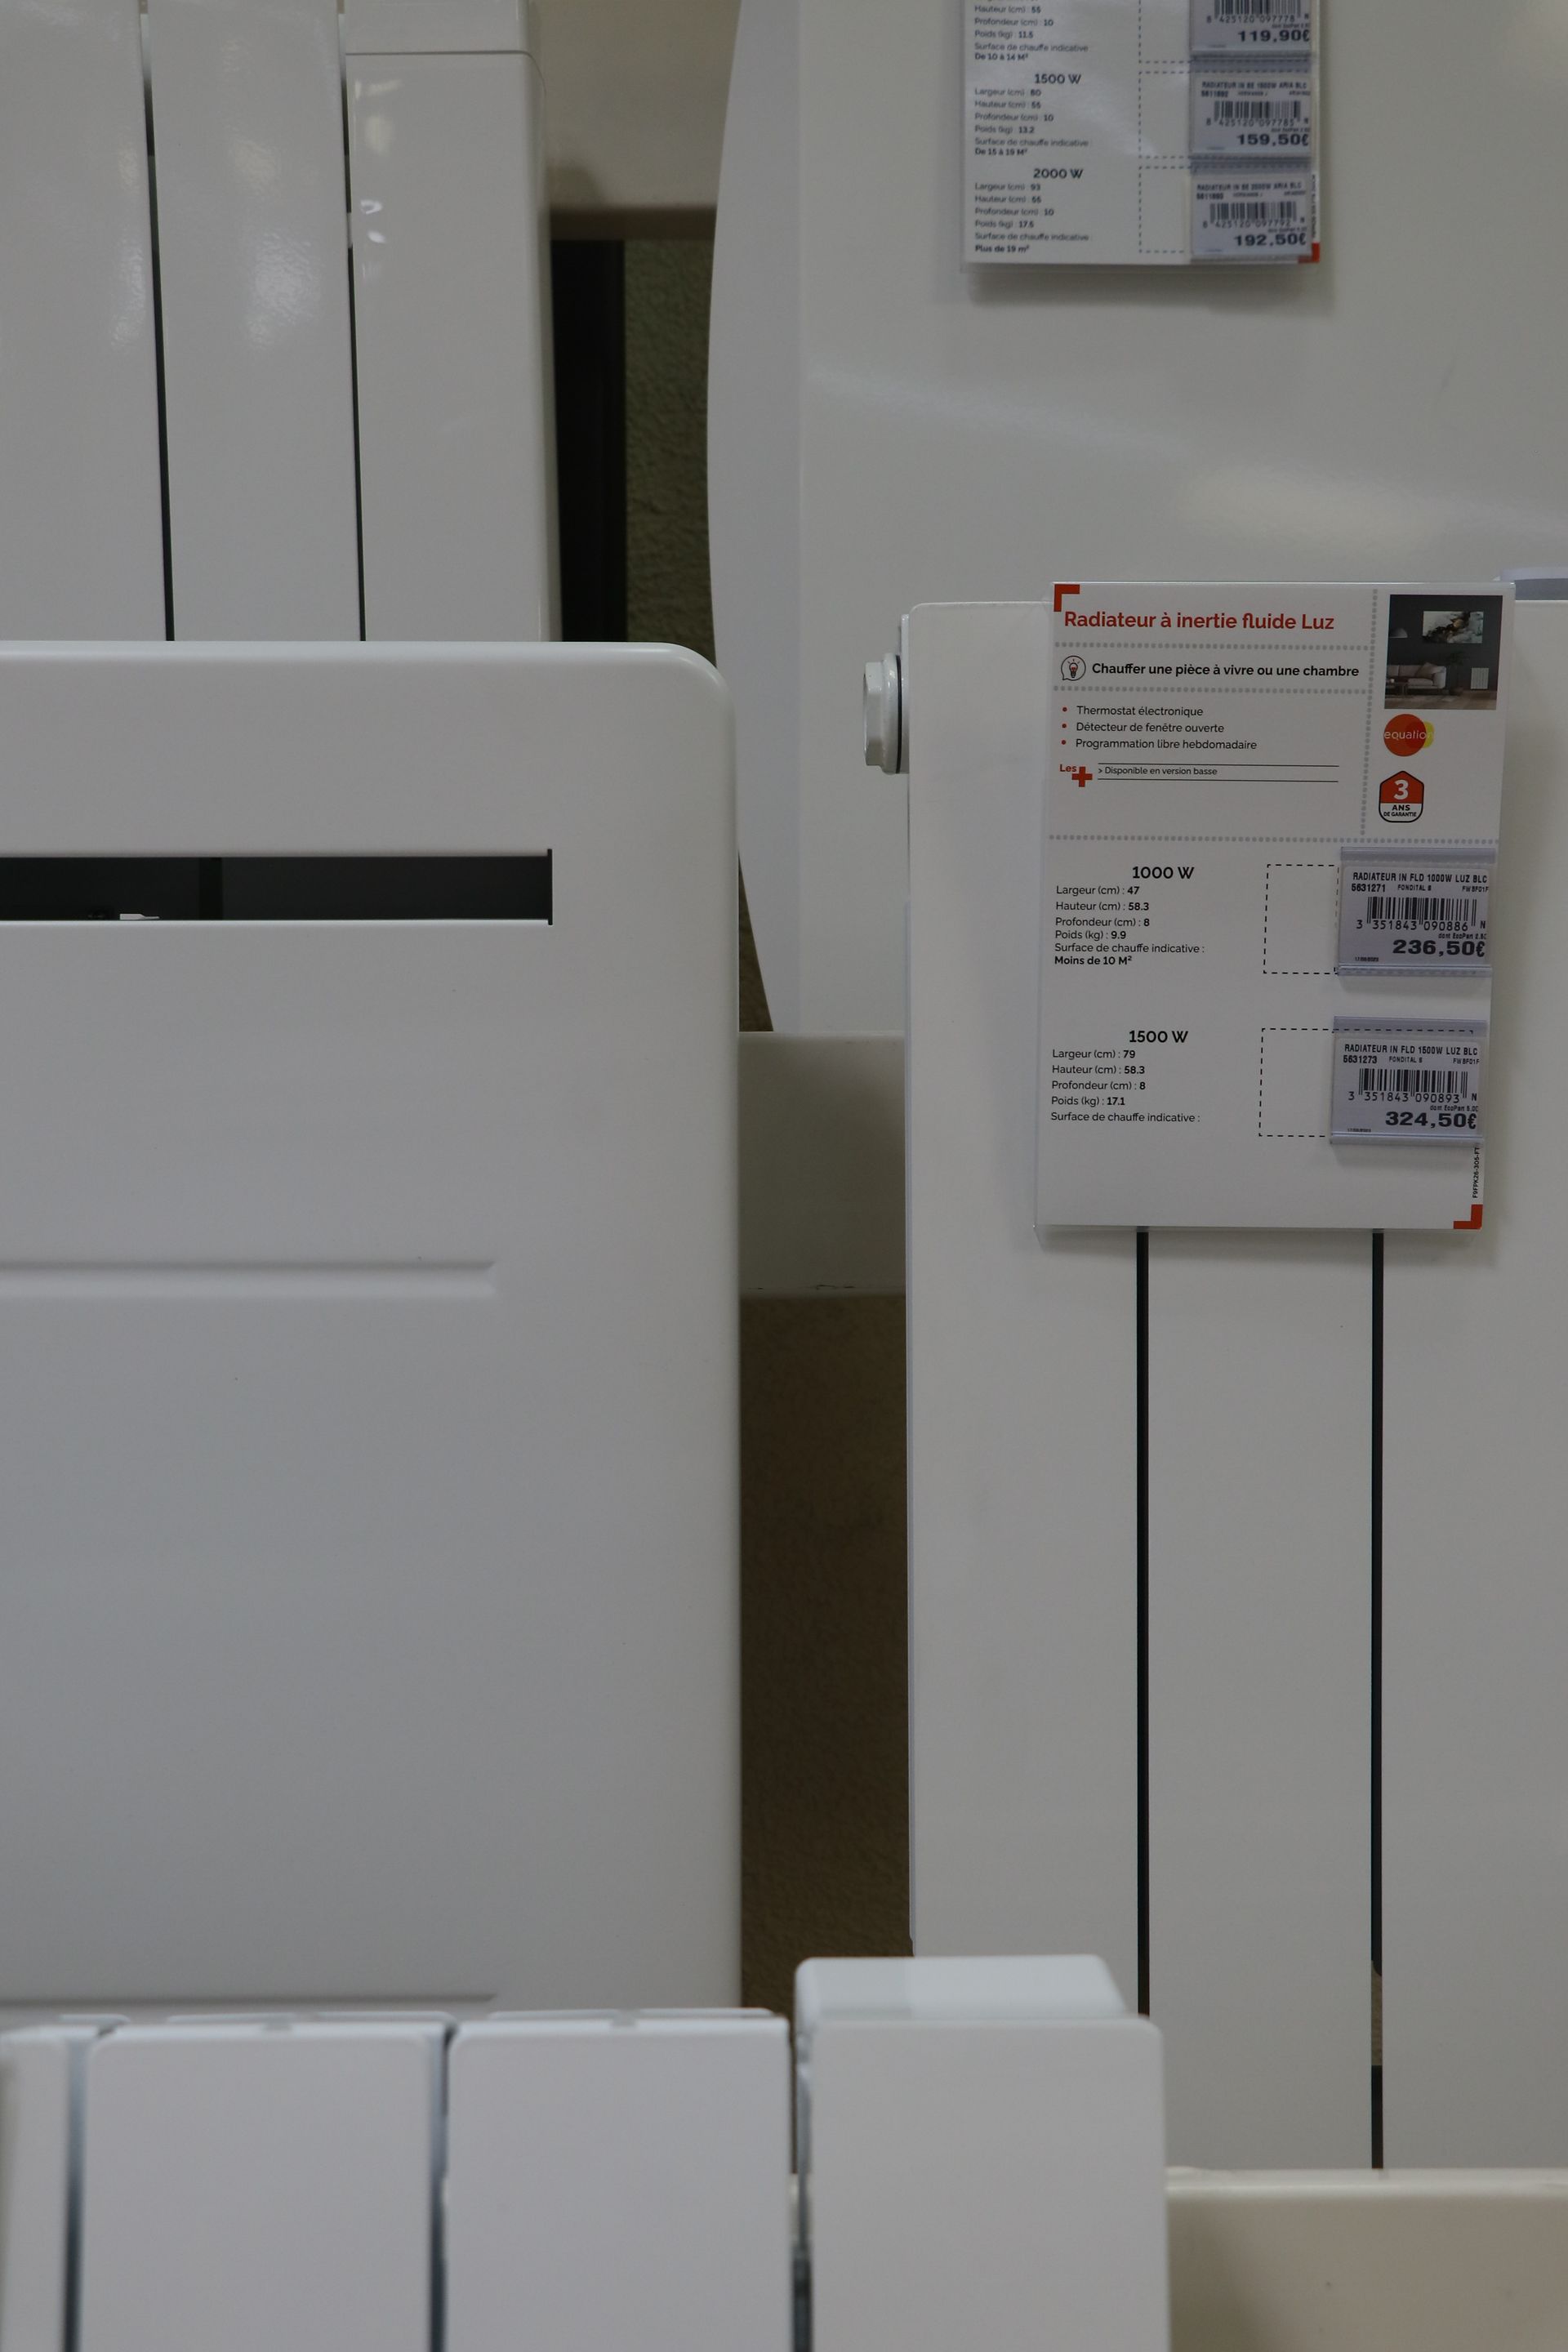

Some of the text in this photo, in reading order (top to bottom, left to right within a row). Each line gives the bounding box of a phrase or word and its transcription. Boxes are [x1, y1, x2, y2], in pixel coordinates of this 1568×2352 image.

[1035, 74, 1081, 84] 1500 W
[1033, 168, 1083, 179] 2000 W
[1064, 612, 1334, 630] Radiateur à inertie fluide Luz
[1092, 663, 1359, 677] Chauffer une pièce à vivre ou une chambre
[1076, 706, 1203, 718] Thermostat électronique
[1076, 722, 1224, 733] Détecteur de fenêtre ouverte
[1076, 739, 1257, 751] Programmation libre hebdomadaire
[1059, 764, 1077, 773] Les
[1105, 767, 1147, 776] Disponible
[1161, 767, 1191, 775] version
[1393, 779, 1410, 800] 3
[1133, 866, 1194, 880] 1000 W
[1353, 872, 1487, 883] RADIATEUR IN FLD 1000W LUZ BLC
[1057, 885, 1139, 897] Largeur (cm) 47
[1352, 883, 1386, 893] 5631271
[1056, 902, 1148, 911] Hauteur (cm) 58.3
[1055, 917, 1149, 927] Profondeur (cm) 8
[1356, 920, 1486, 931] 3 351843 090886 N
[1055, 929, 1125, 942] Poids (kg) 9.9
[1055, 942, 1199, 953] Surface de chauffe indicative
[1392, 939, 1486, 957] 236,50€
[1054, 956, 1131, 965] Moins de 10 M²
[1129, 1030, 1187, 1043] 1500 W
[1053, 1049, 1135, 1061] Largeur (cm) 79
[1344, 1044, 1478, 1055] RADIATEUR IN FLD 1500W LUZ BLC
[1343, 1055, 1378, 1064] 5631273
[1052, 1065, 1144, 1075] Hauteur (cm) 58.3
[1052, 1080, 1145, 1090] Profondeur (cm) 8
[1052, 1096, 1125, 1108] Poids (kg) 17.1
[1348, 1091, 1477, 1103] 3 351843 090893 N
[1051, 1111, 1195, 1122] Surface de chauffe indicative
[1385, 1111, 1477, 1129] 324,50€
